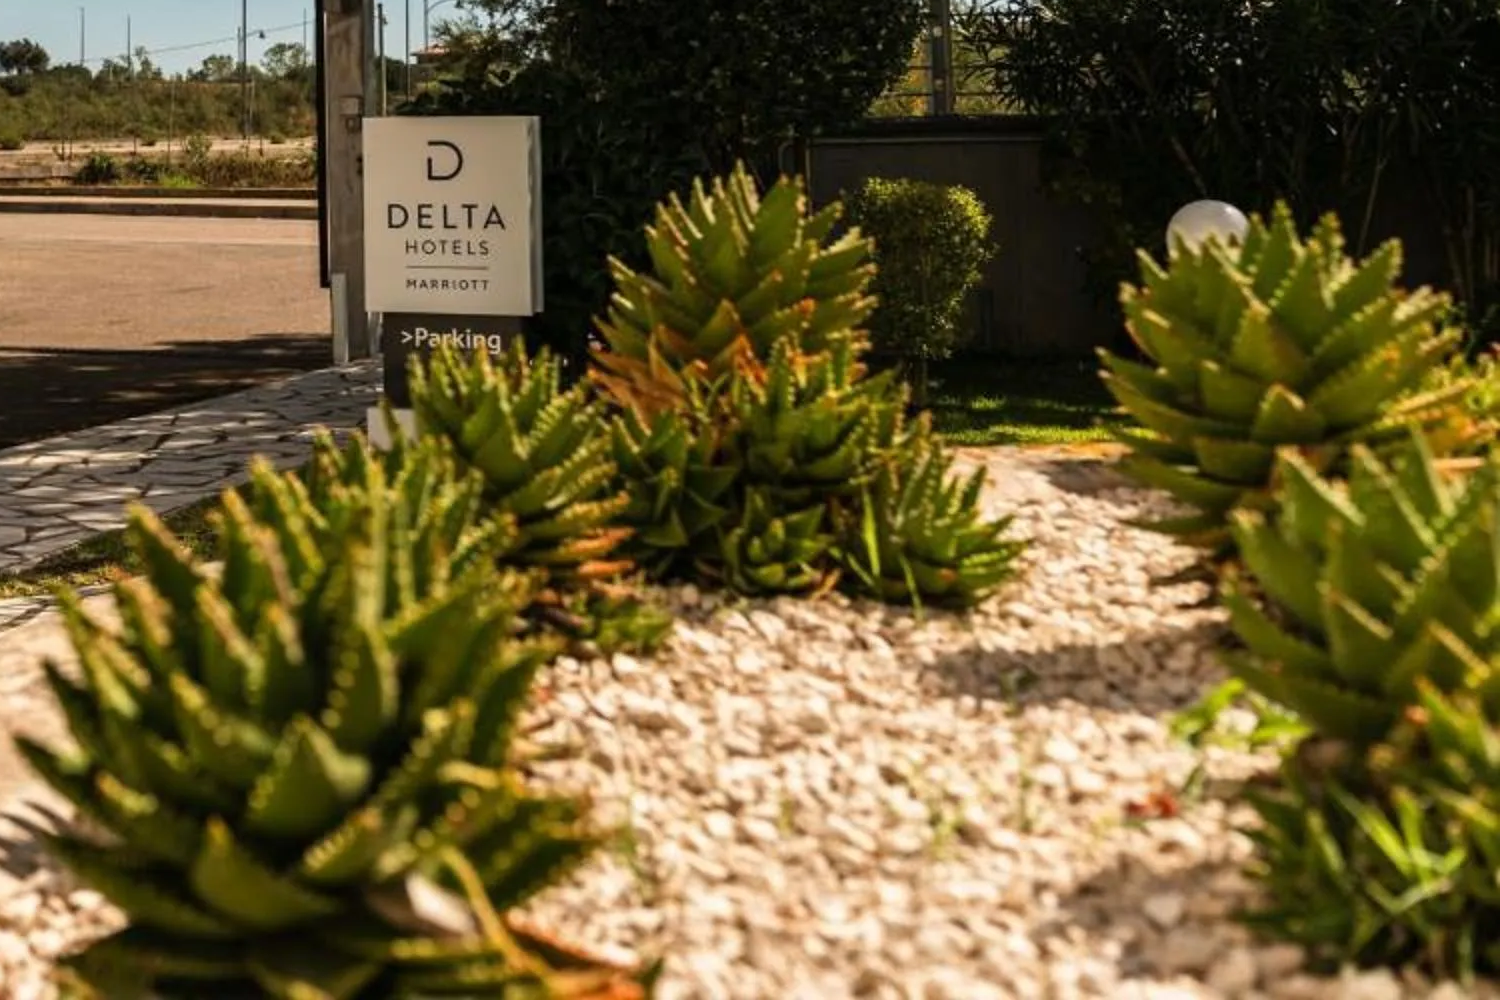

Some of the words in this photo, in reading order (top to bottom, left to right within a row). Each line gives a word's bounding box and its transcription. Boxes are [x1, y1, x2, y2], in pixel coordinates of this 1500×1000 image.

[386, 203, 507, 230] DELTA
[404, 239, 490, 256] HOTELS
[405, 278, 490, 291] MARRIOTT
